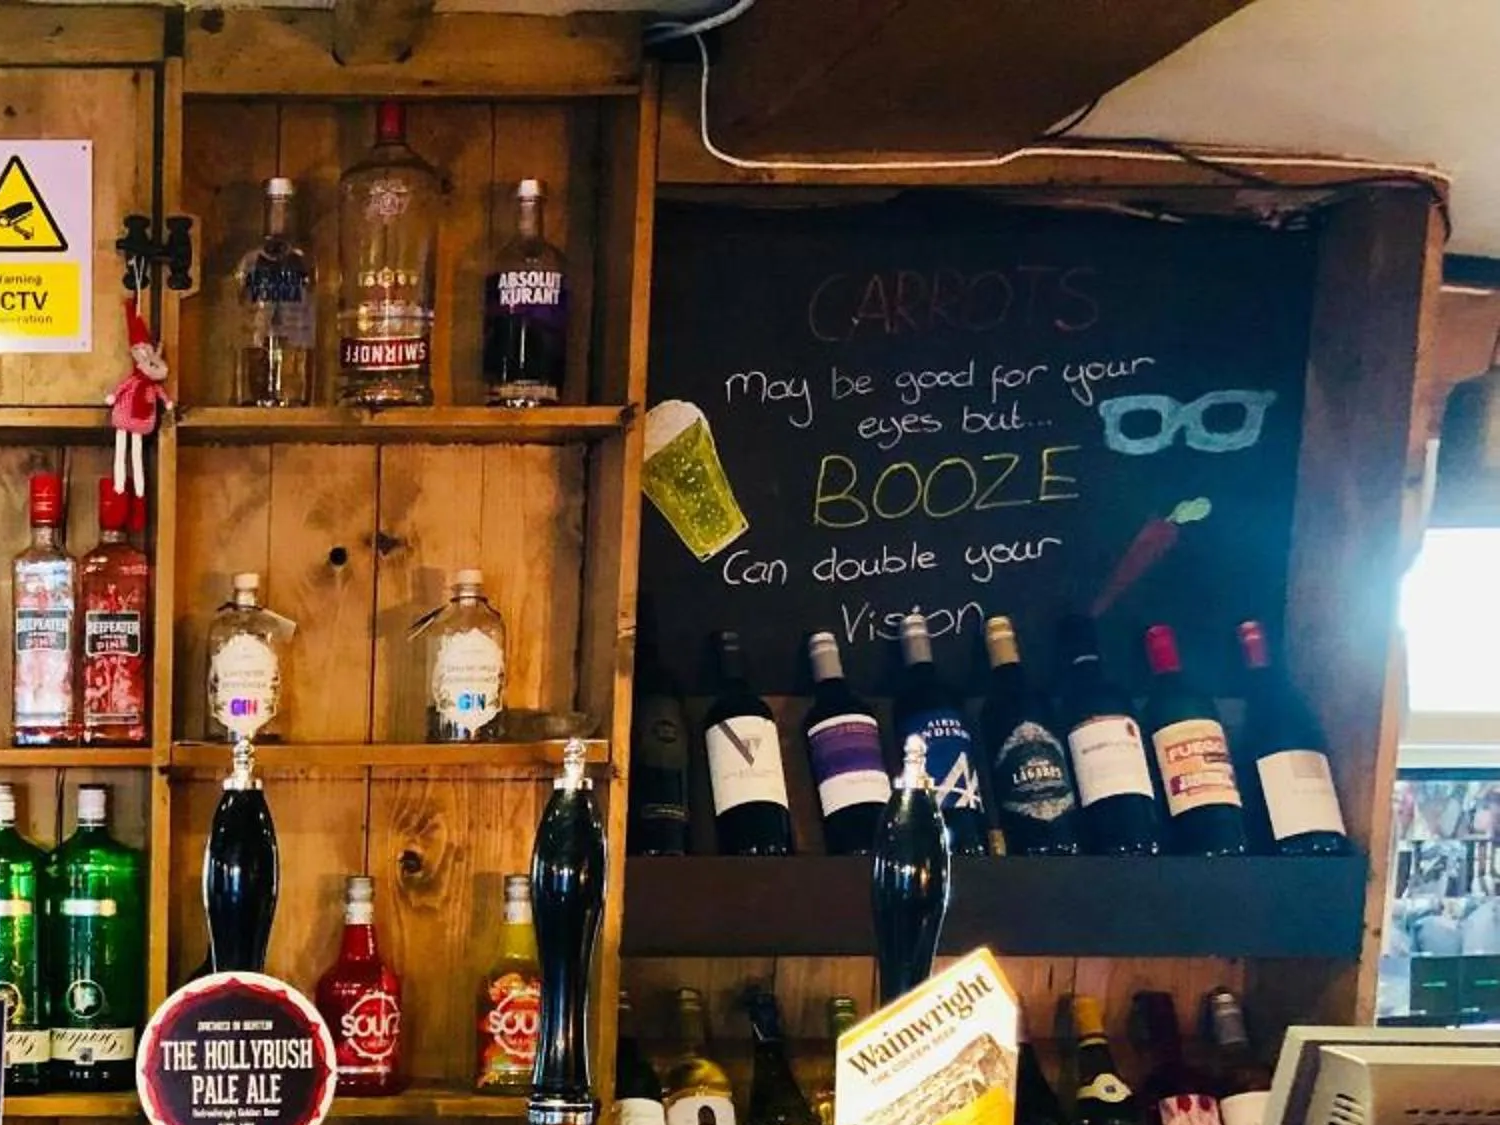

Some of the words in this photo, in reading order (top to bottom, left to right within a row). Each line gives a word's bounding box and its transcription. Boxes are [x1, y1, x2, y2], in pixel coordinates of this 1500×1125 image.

[498, 272, 562, 288] ABSOLUT
[808, 265, 1100, 342] CARROTS
[344, 338, 428, 366] SMIRNOFF
[724, 371, 814, 429] May
[831, 366, 873, 398] be
[896, 358, 976, 403] good
[991, 362, 1049, 405] for
[1063, 354, 1156, 406] your
[857, 410, 943, 450] eyes
[814, 445, 1082, 529] BOOZE
[723, 550, 788, 586] Can
[812, 533, 936, 584] double
[965, 534, 1063, 584] your
[846, 973, 993, 1077] Wainwright
[159, 1041, 198, 1071] THE
[204, 1038, 314, 1070] HOLLYBUSH
[191, 1074, 240, 1105] PALE
[245, 1073, 282, 1104] ALE
